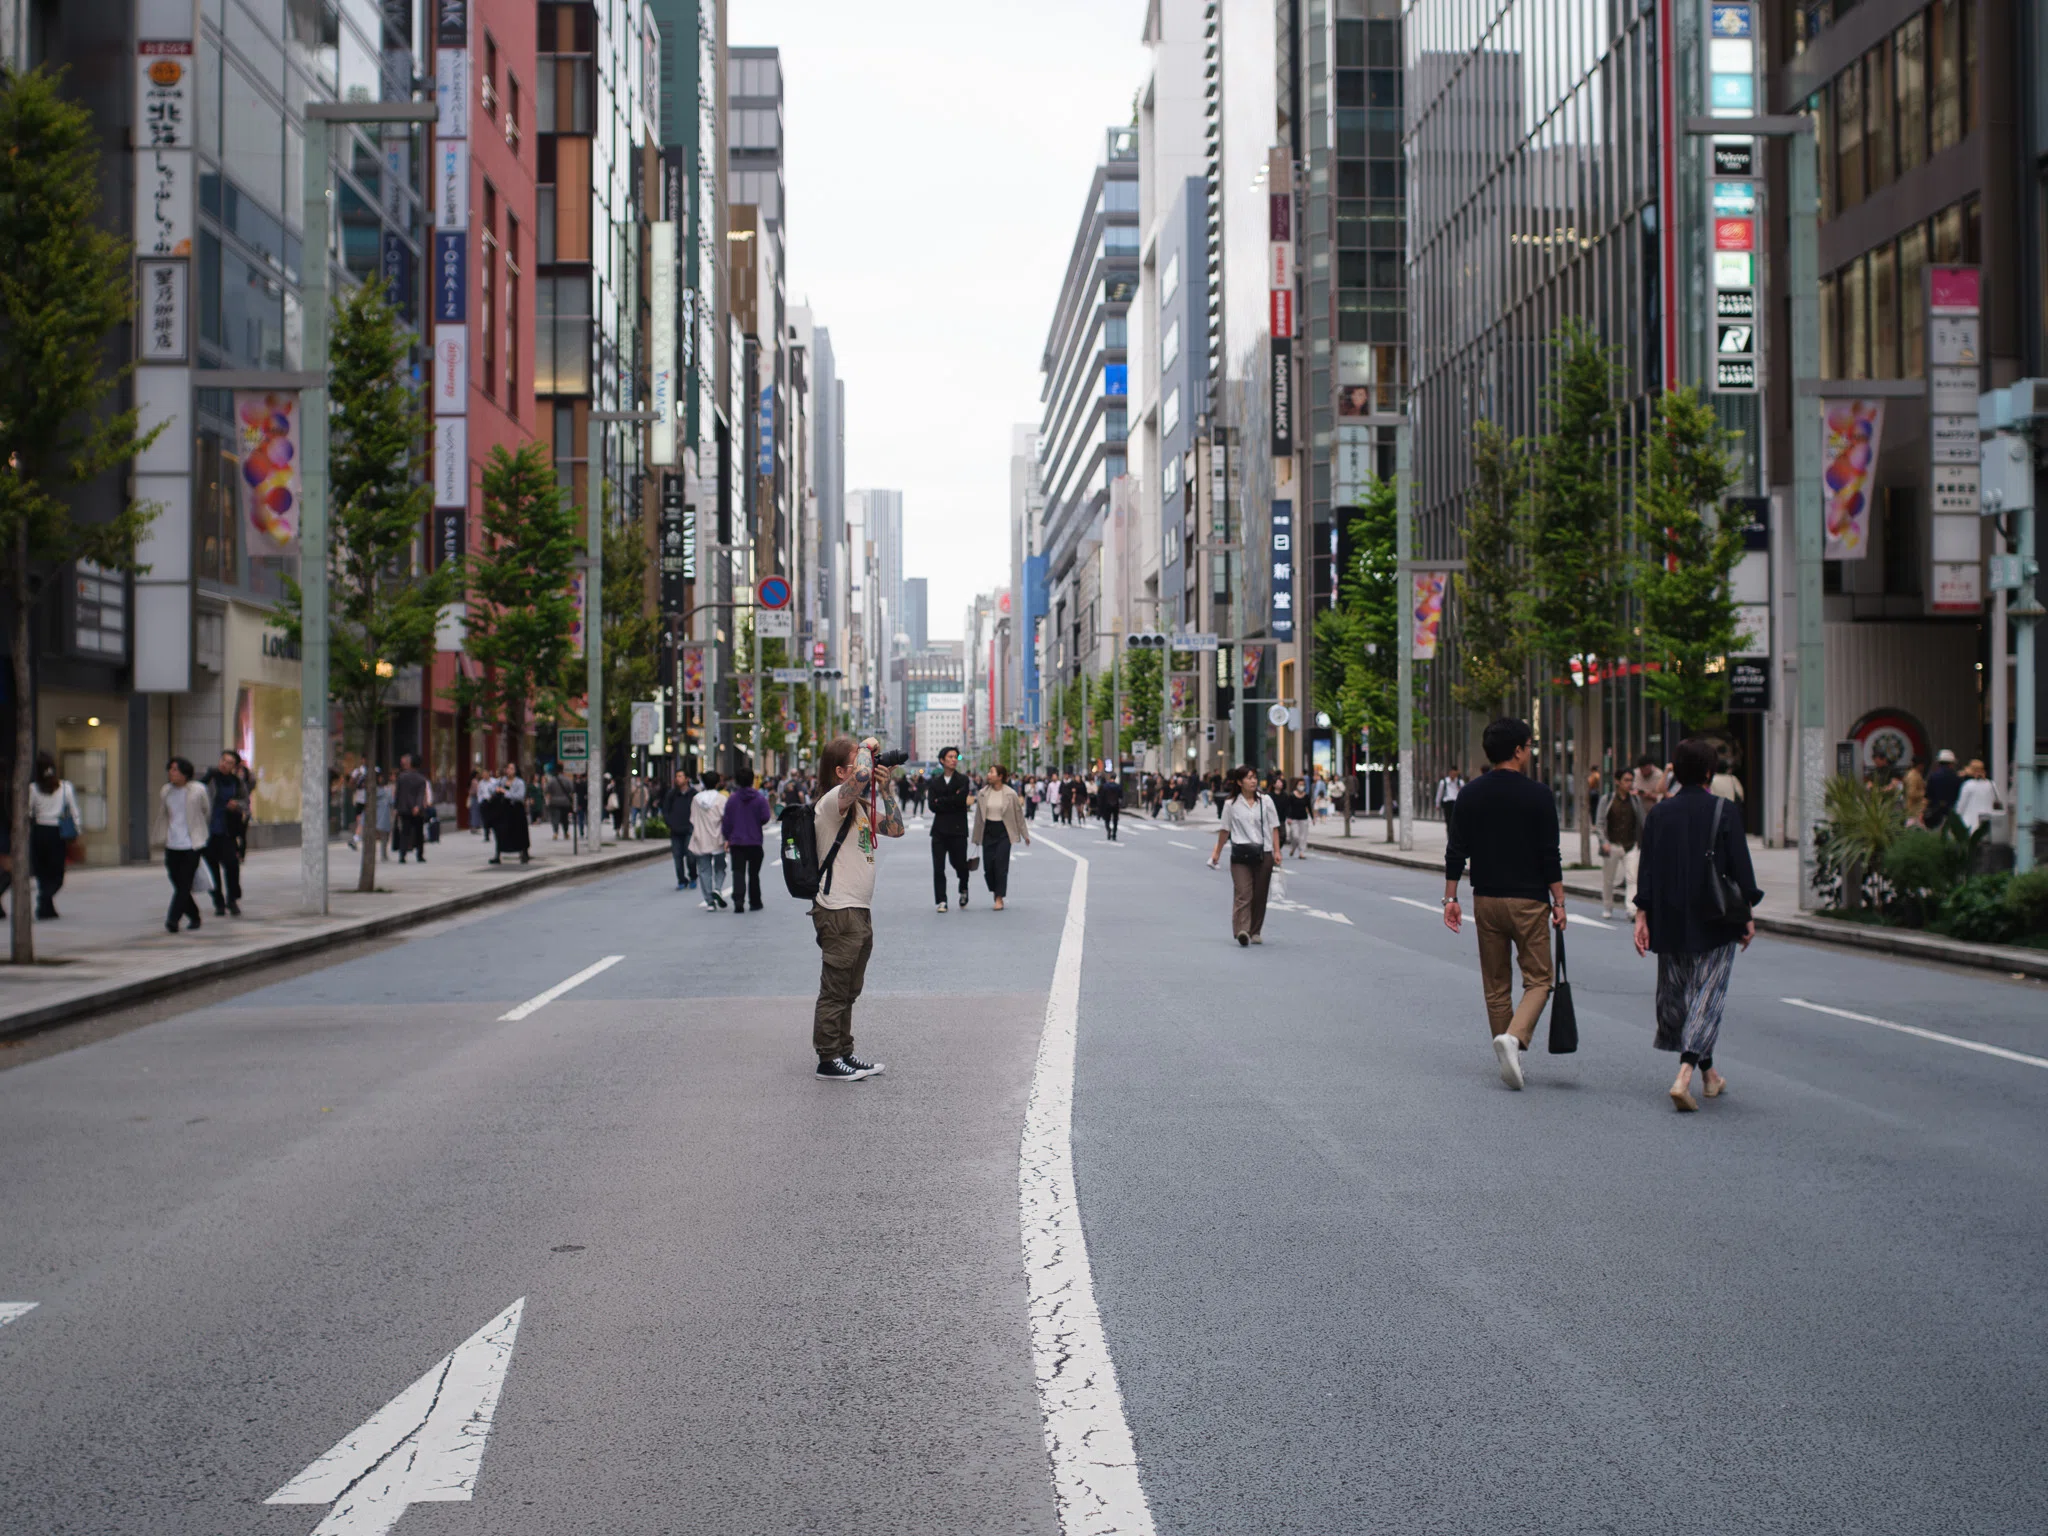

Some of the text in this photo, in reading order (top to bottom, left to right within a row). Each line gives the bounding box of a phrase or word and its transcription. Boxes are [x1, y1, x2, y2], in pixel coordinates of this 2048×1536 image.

[154, 267, 174, 349] 星乃珈琲店
[443, 236, 459, 317] TORAIZ
[1275, 354, 1288, 430] MONTBLANC
[683, 511, 696, 578] DAMIANI
[1273, 534, 1291, 609] 日新堂
